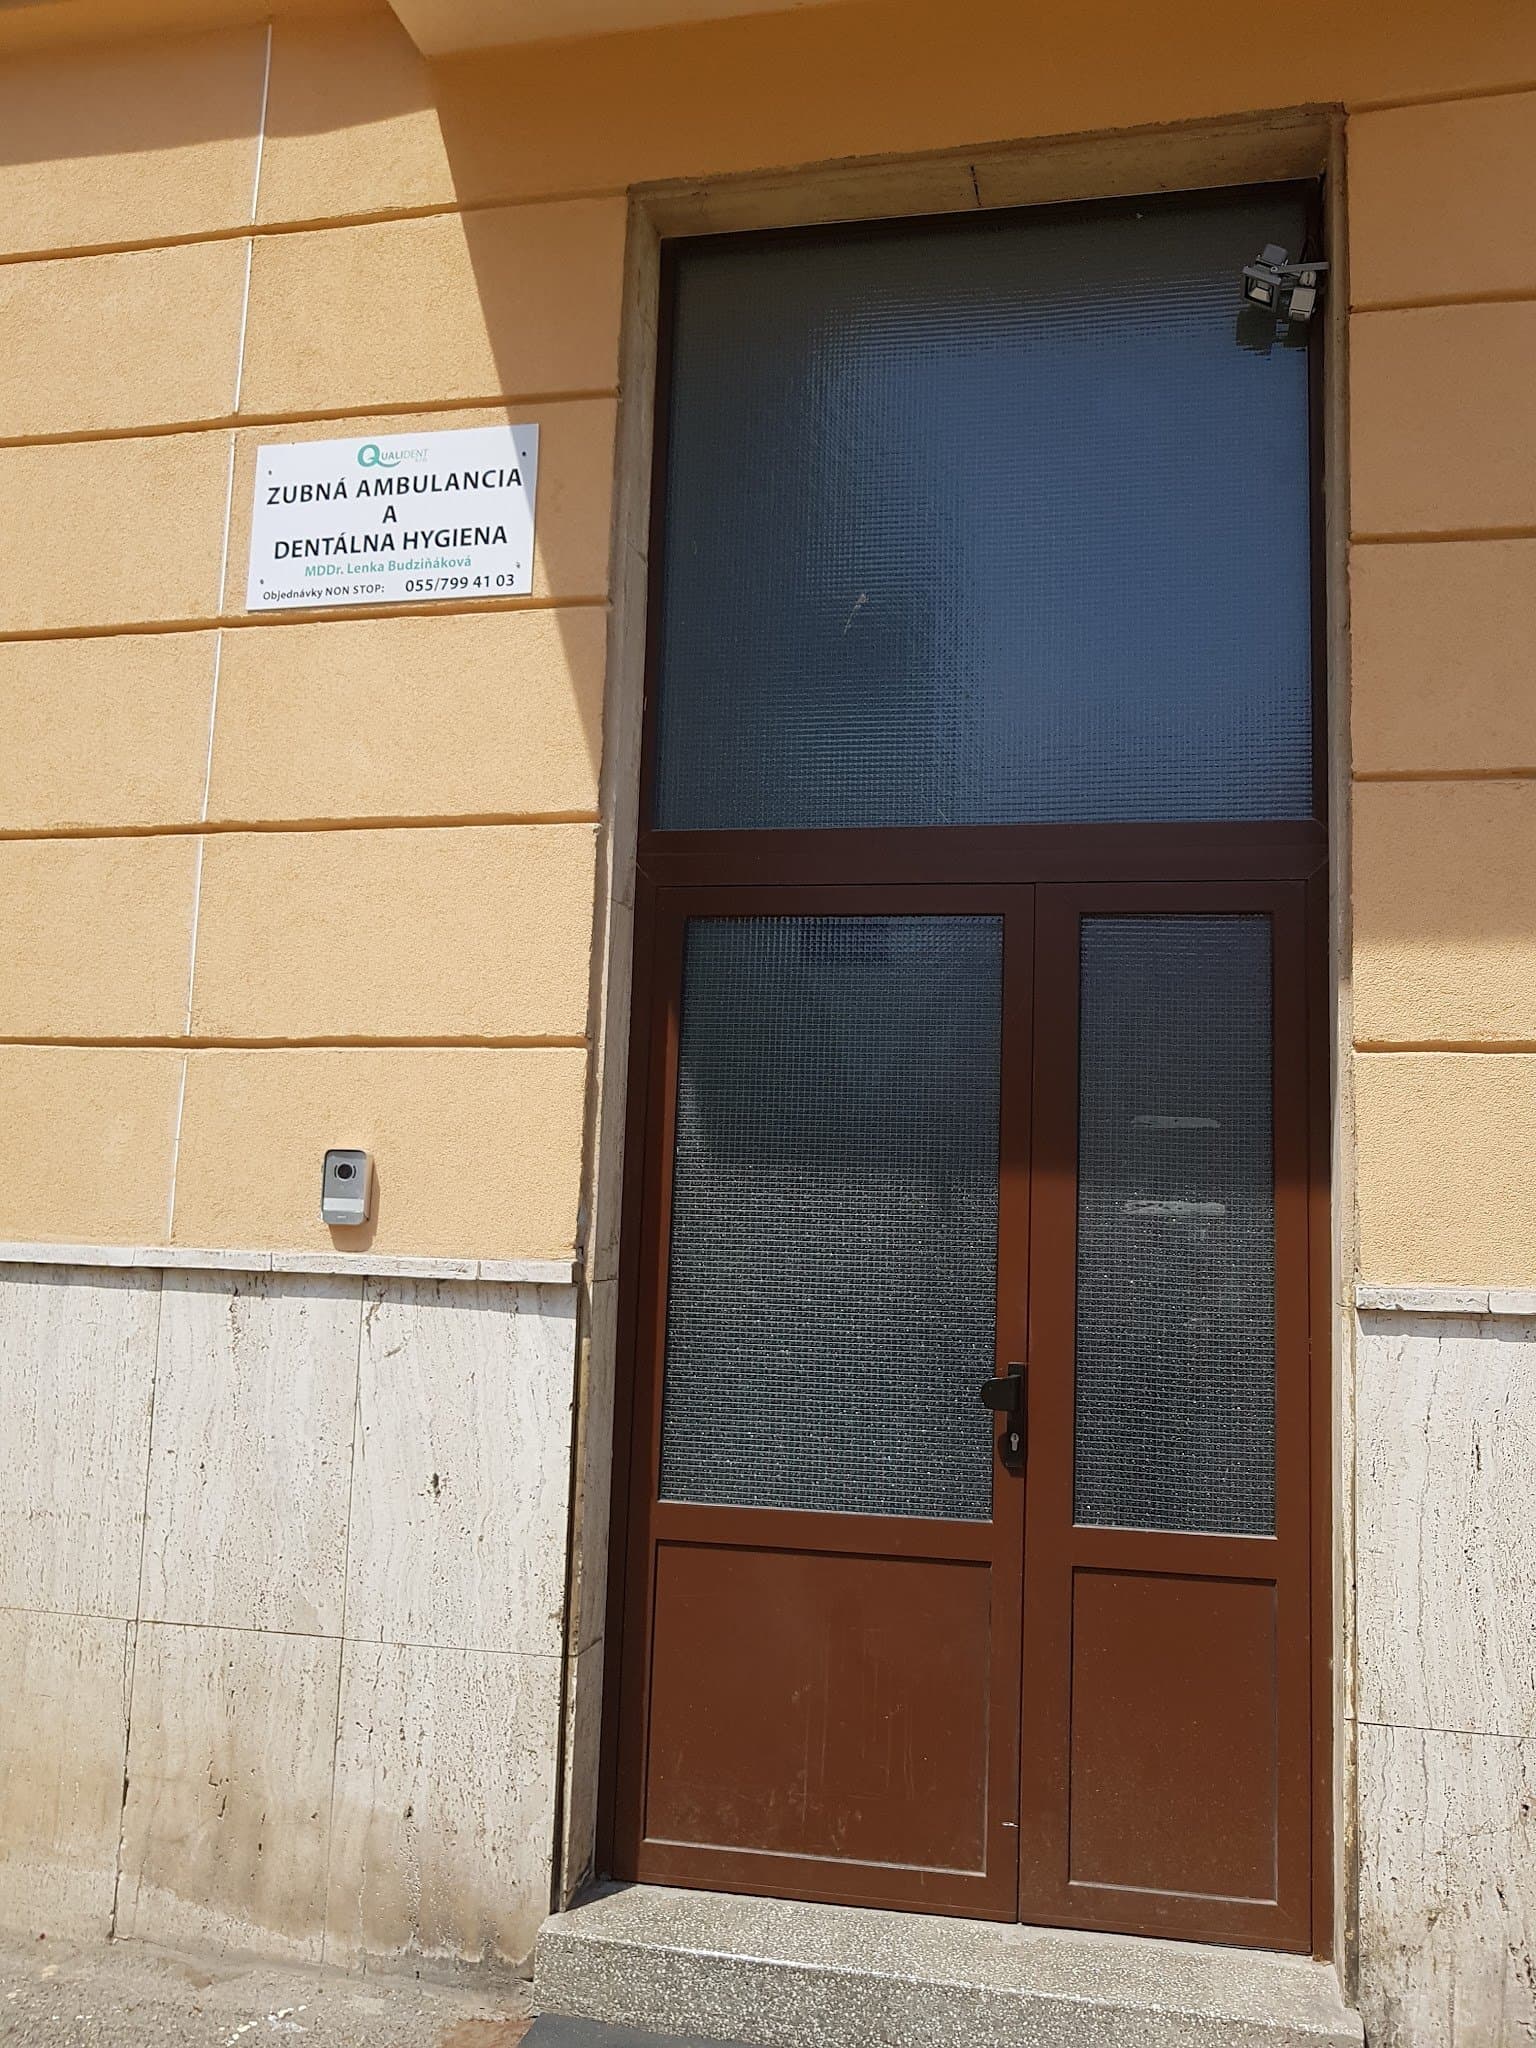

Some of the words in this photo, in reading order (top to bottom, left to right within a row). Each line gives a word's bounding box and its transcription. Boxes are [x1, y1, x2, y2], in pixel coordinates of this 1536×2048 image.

[266, 476, 348, 505] ZUBNÁ
[356, 468, 522, 498] AMBULANCIA
[382, 505, 397, 524] A
[274, 531, 395, 560] DENTÁLNA
[402, 525, 508, 551] HYGIENA
[304, 564, 344, 577] MDDr.
[346, 560, 385, 574] Lenka
[263, 588, 323, 602] Objednávky
[325, 586, 350, 597] NON
[352, 583, 385, 595] STOP:
[405, 576, 469, 593] 055/799
[472, 575, 490, 589] 41
[496, 573, 515, 588] 03
